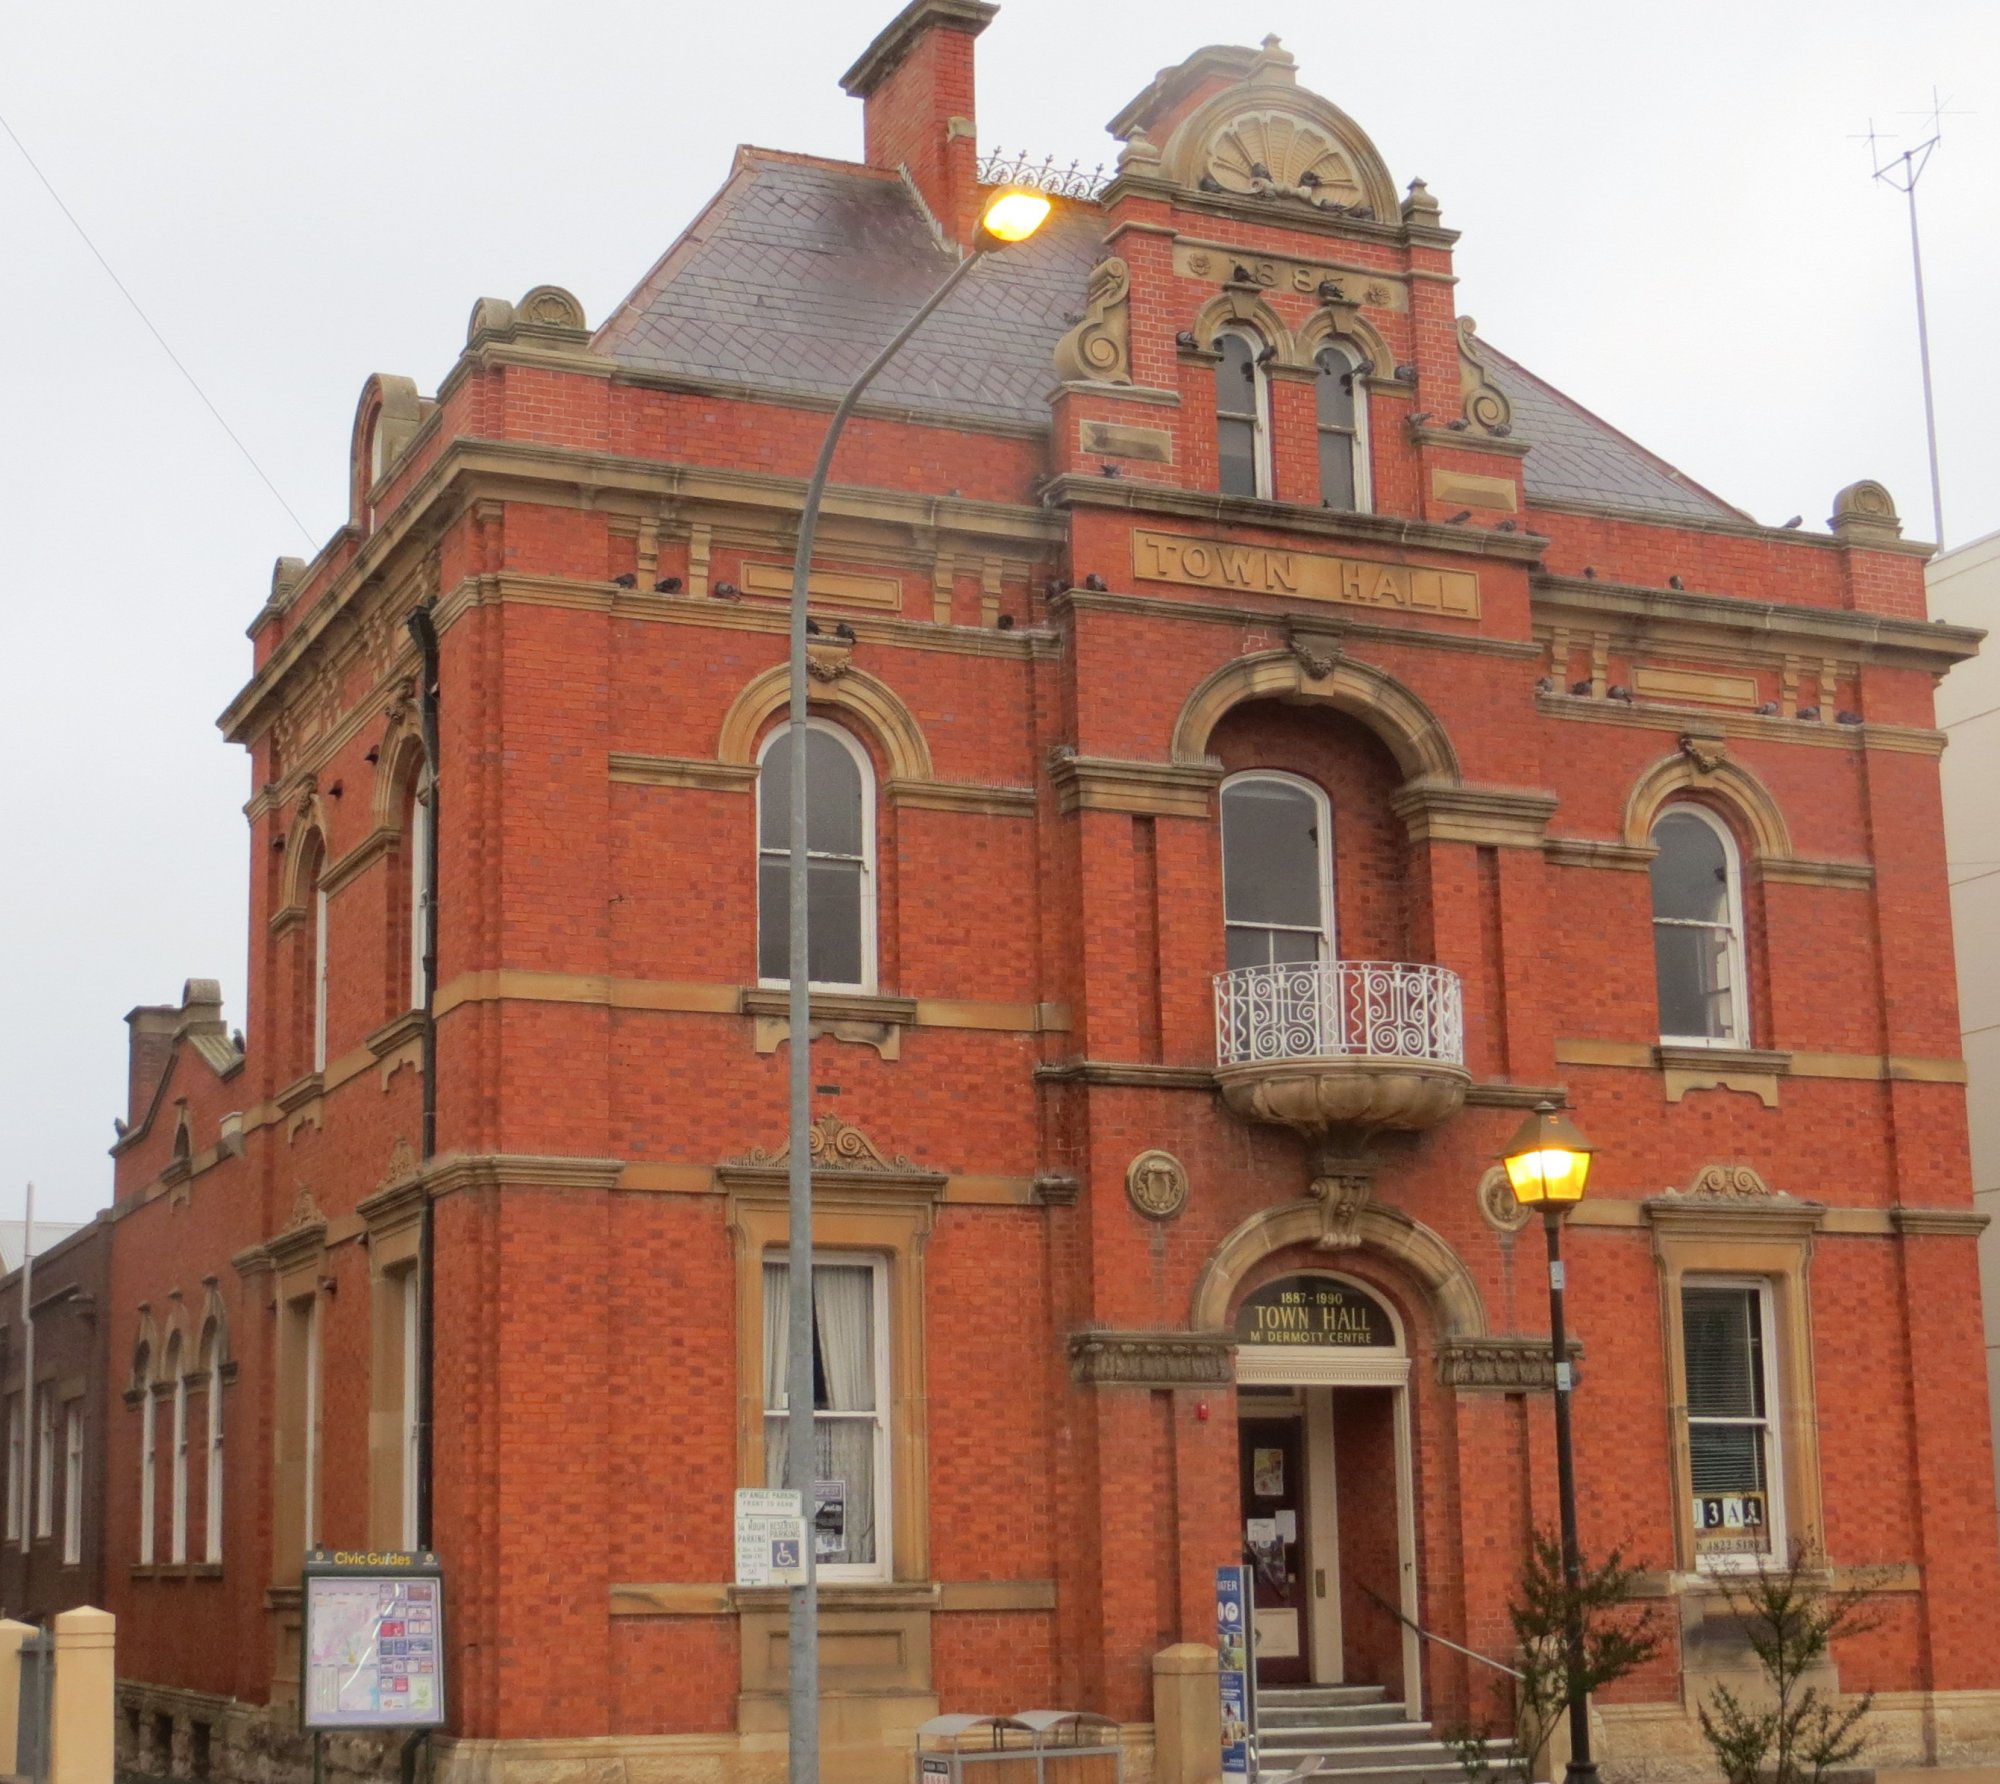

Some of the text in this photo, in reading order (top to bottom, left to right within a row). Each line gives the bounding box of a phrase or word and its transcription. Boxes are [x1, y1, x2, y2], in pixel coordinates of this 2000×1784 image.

[1146, 537, 1468, 612] TOWN HALL
[1255, 1306, 1371, 1331] TOWN HALL
[1267, 1331, 1324, 1343] DERMOTT
[1329, 1332, 1372, 1343] CENTRE
[772, 1492, 799, 1500] PARKING
[738, 1534, 766, 1543] PARKING
[769, 1530, 801, 1538] PARKING
[334, 1552, 411, 1565] Civic Guides
